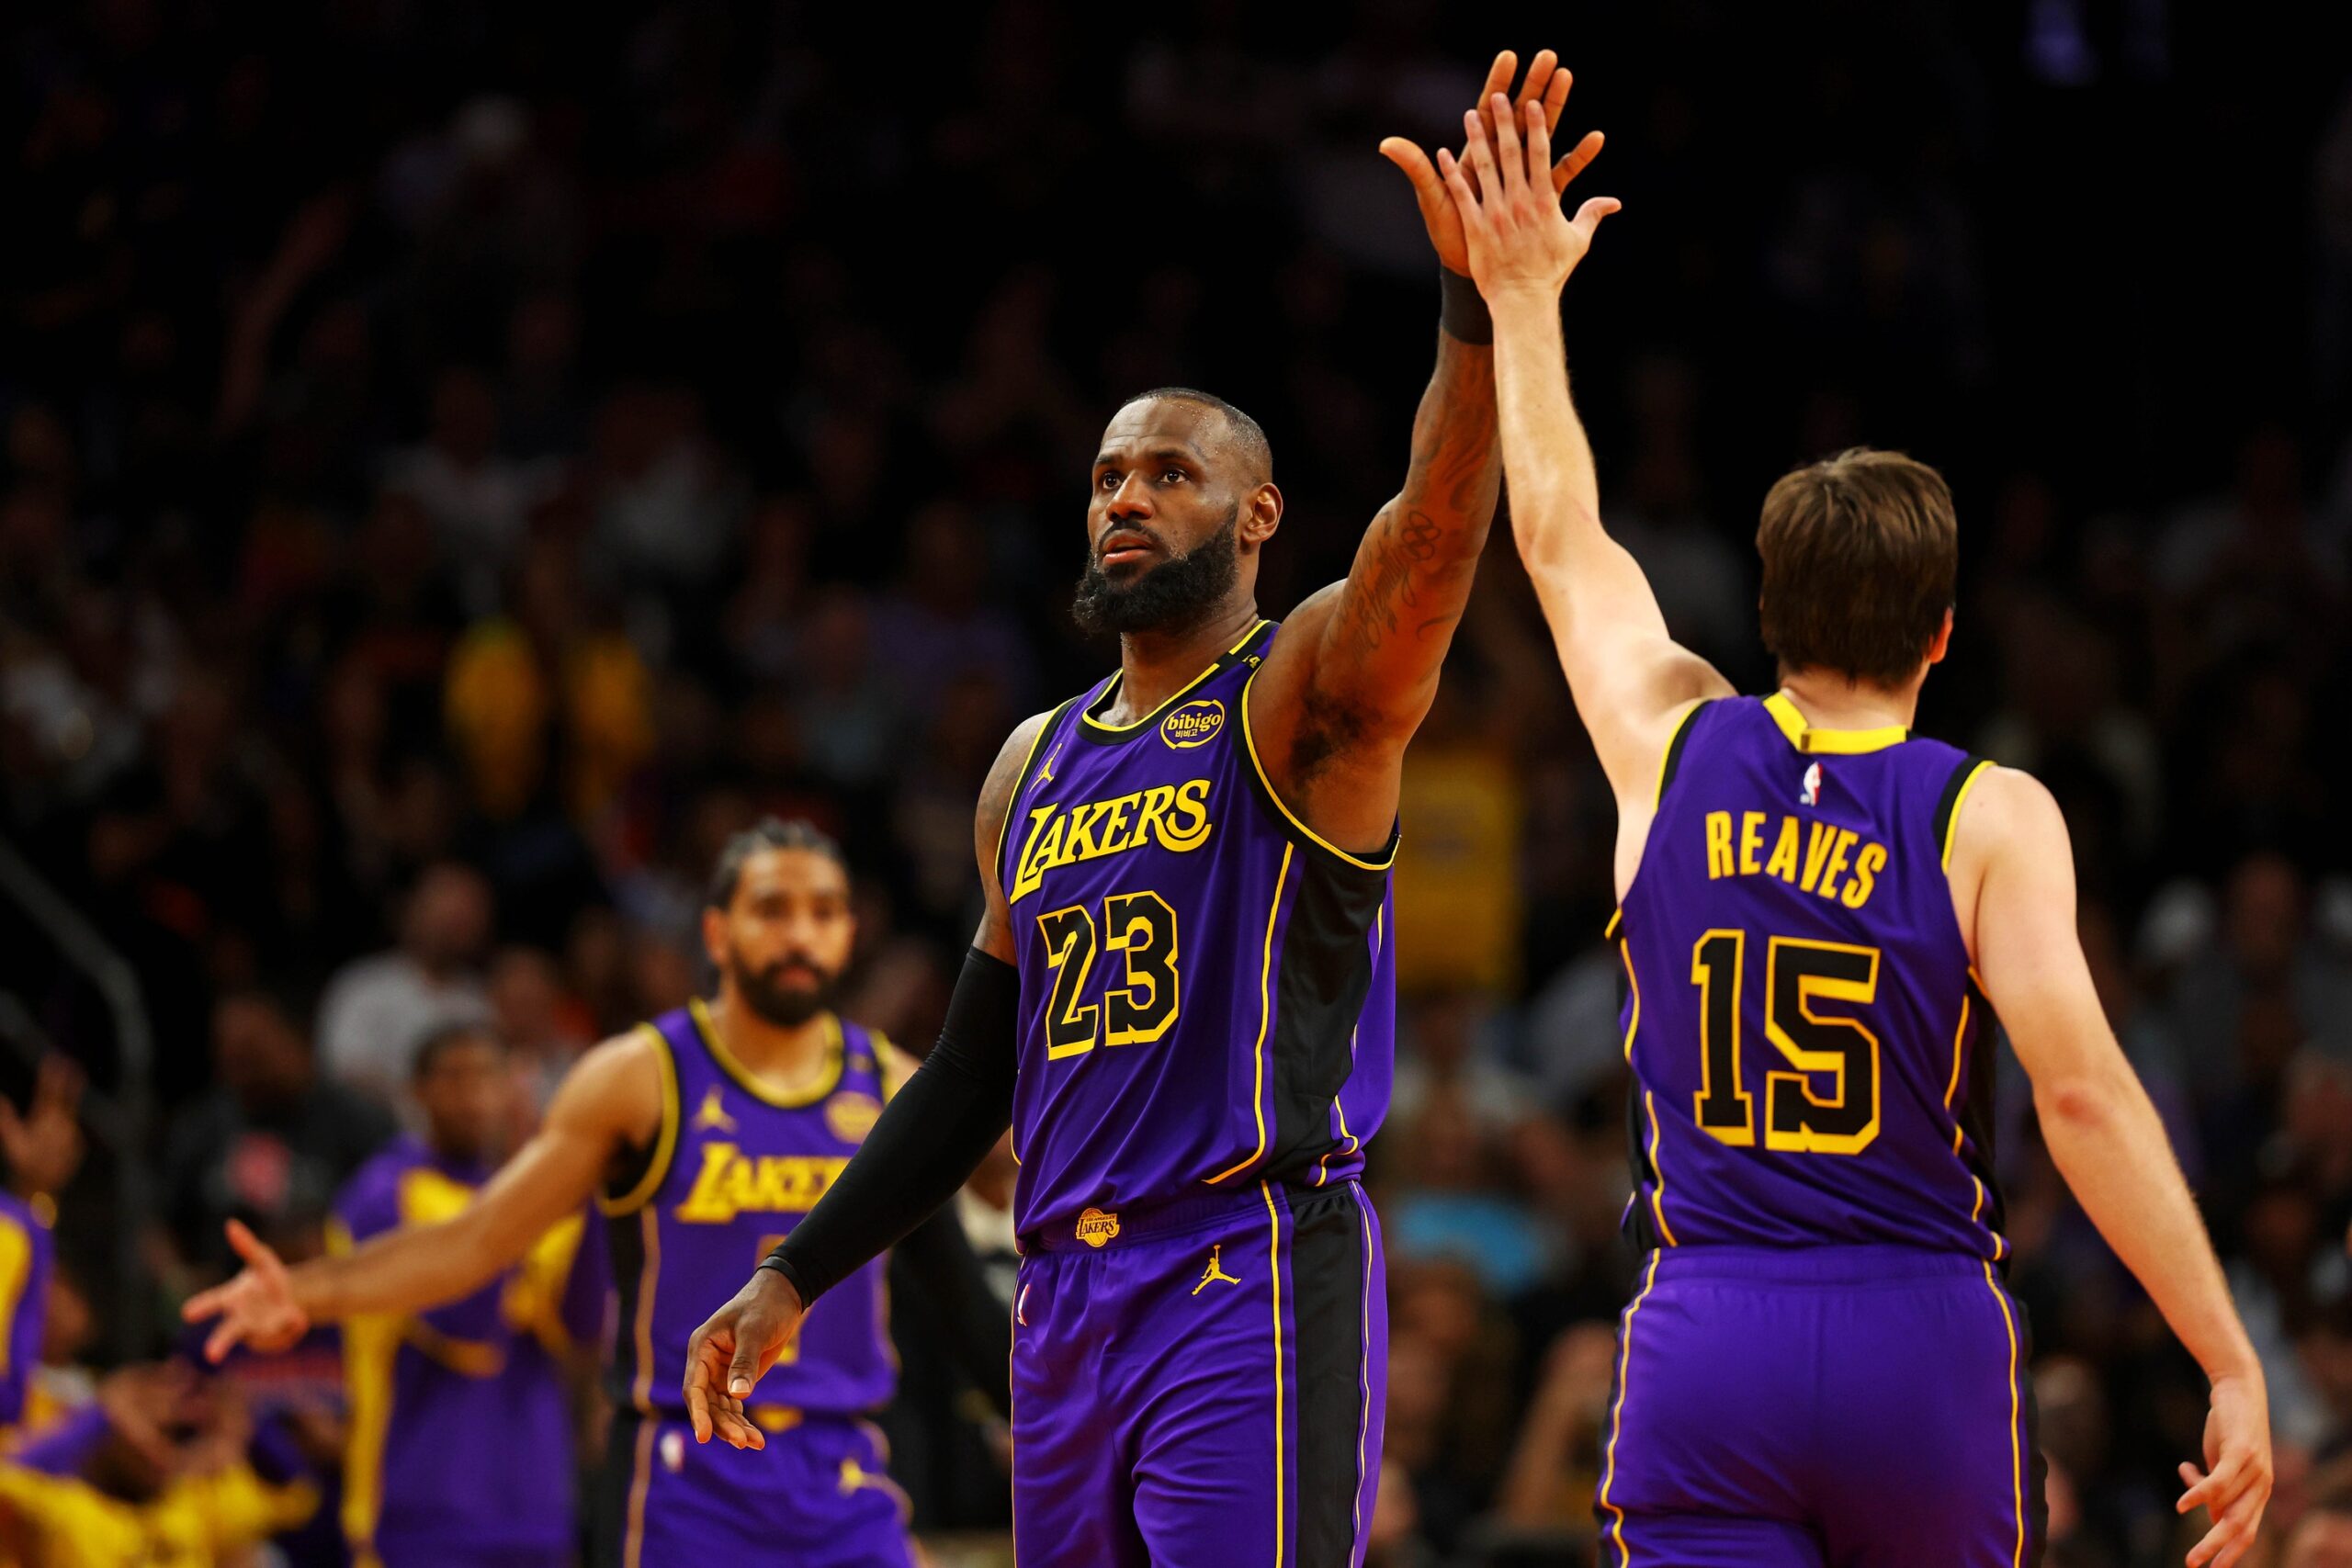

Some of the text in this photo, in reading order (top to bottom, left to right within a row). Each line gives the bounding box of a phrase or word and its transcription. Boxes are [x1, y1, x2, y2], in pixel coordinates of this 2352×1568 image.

[1167, 712, 1222, 732] bibigo
[1010, 778, 1214, 905] LAKERS
[1704, 809, 1888, 909] REAVES
[1035, 889, 1180, 1062] 23
[1690, 927, 1881, 1156] 15
[1078, 1218, 1115, 1237] LAKERS
